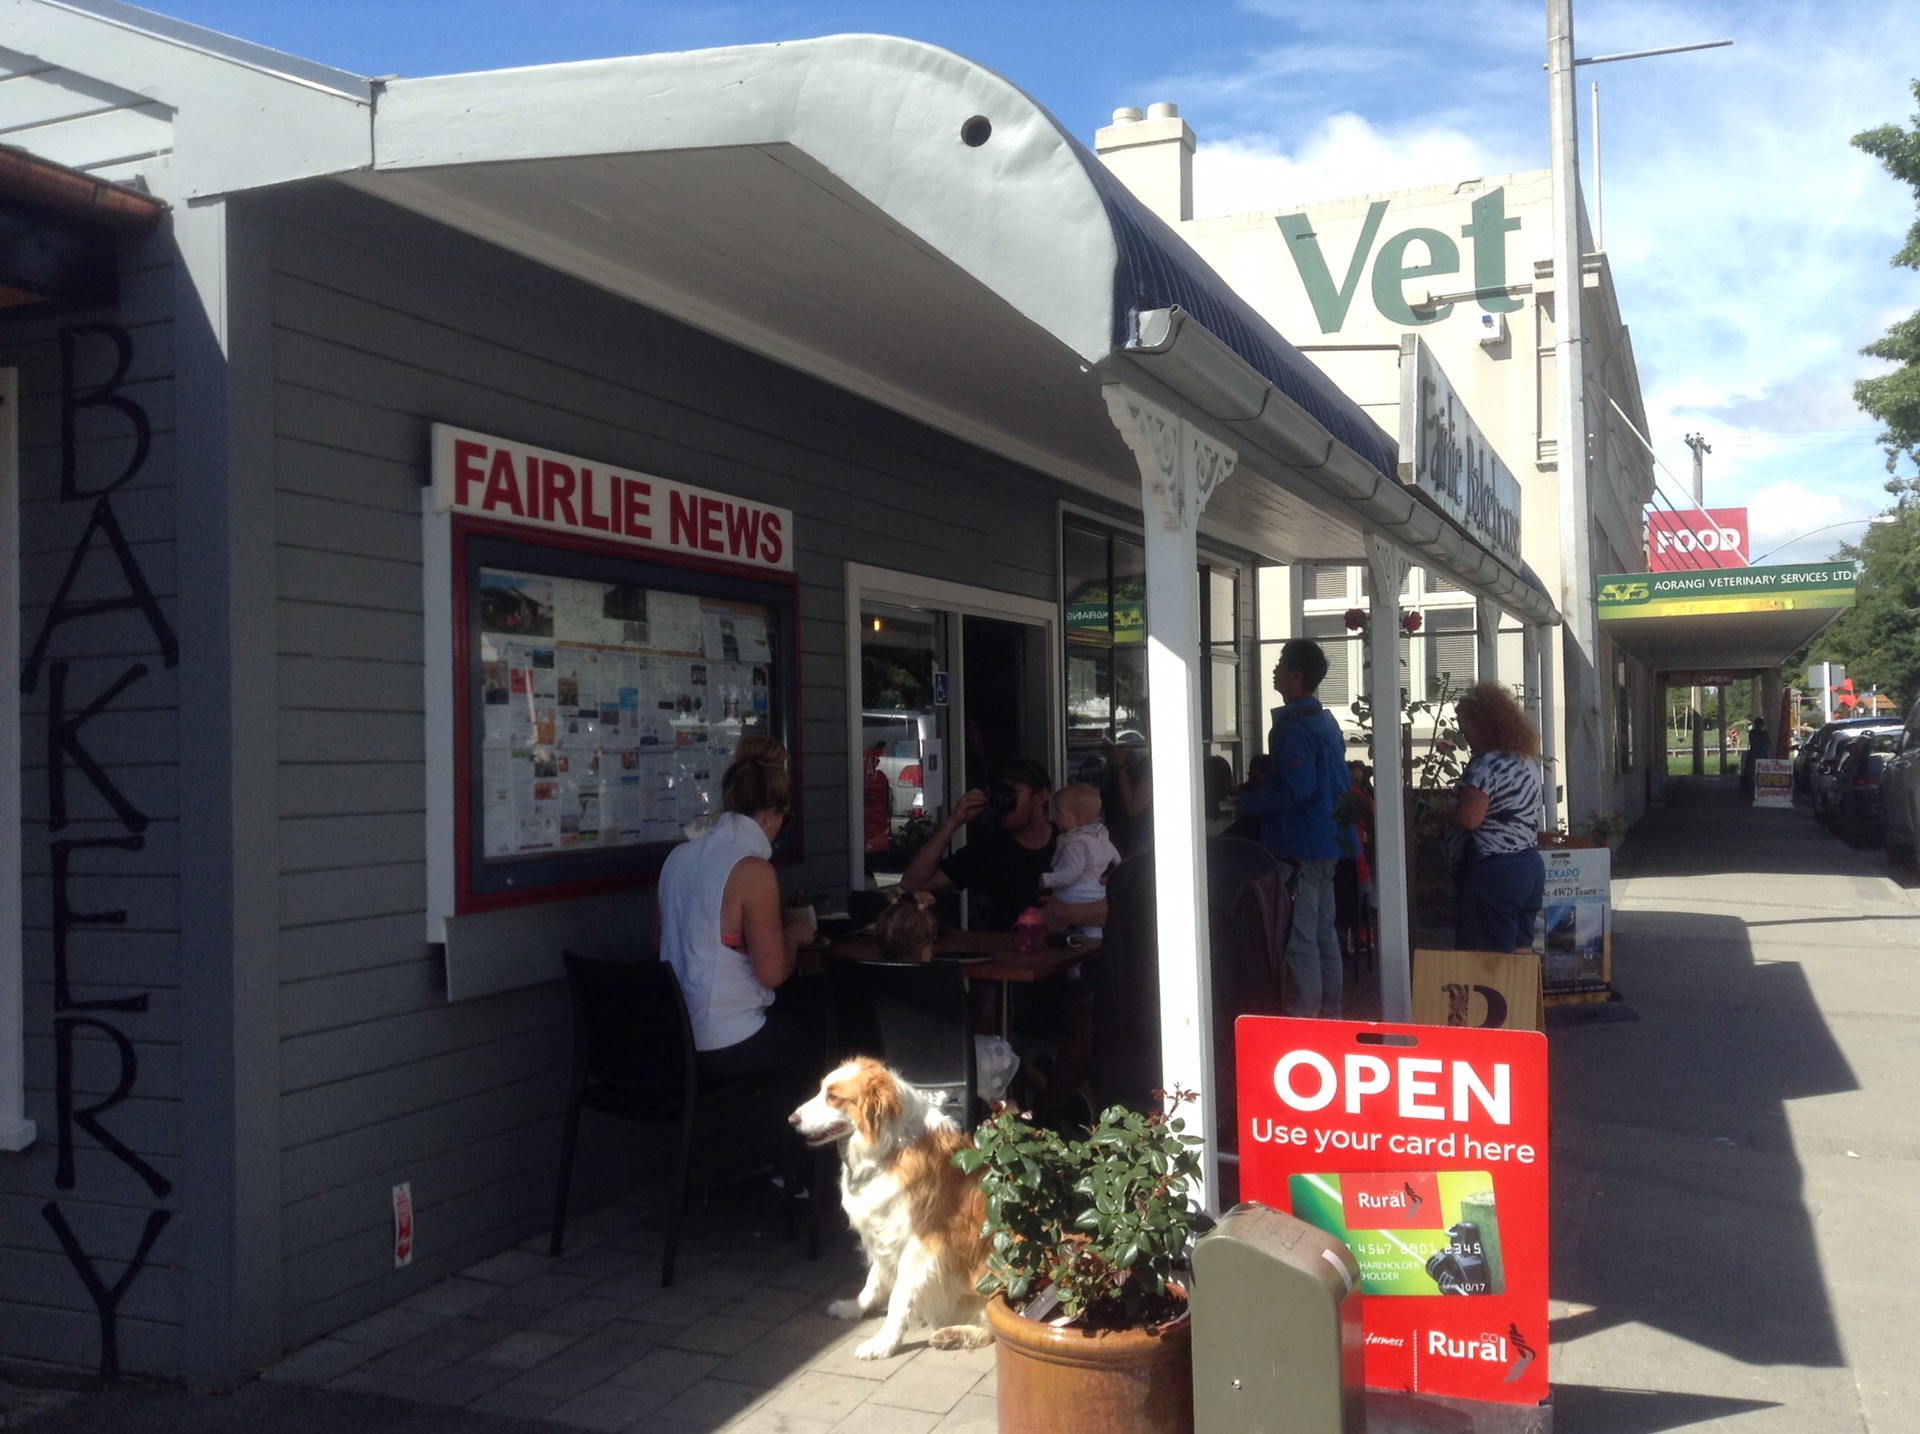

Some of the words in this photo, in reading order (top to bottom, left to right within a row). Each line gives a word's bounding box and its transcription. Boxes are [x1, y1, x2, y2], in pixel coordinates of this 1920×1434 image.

[1275, 186, 1525, 334] Vet
[454, 439, 652, 540] FAIRLIE
[669, 489, 783, 564] NEWS
[1657, 528, 1742, 554] FOOD
[1654, 579, 1705, 591] AORANGI
[1709, 575, 1777, 588] VETERINARY
[1781, 572, 1828, 584] SERVICES
[1833, 571, 1852, 581] LTD
[20, 322, 180, 1376] BAKERY
[1552, 887, 1573, 897] 4WD
[1575, 886, 1596, 895] Tours
[1273, 1049, 1511, 1125] OPEN
[1252, 1117, 1308, 1145] Use
[1314, 1128, 1382, 1153] your
[1388, 1133, 1456, 1157] card
[1465, 1134, 1536, 1163] here
[1358, 1192, 1407, 1208] Rural
[1358, 1244, 1392, 1255] 4567
[1358, 1261, 1420, 1270] HAREHOLDER
[1460, 1283, 1486, 1292] 10/17
[1429, 1331, 1507, 1363] Rural
